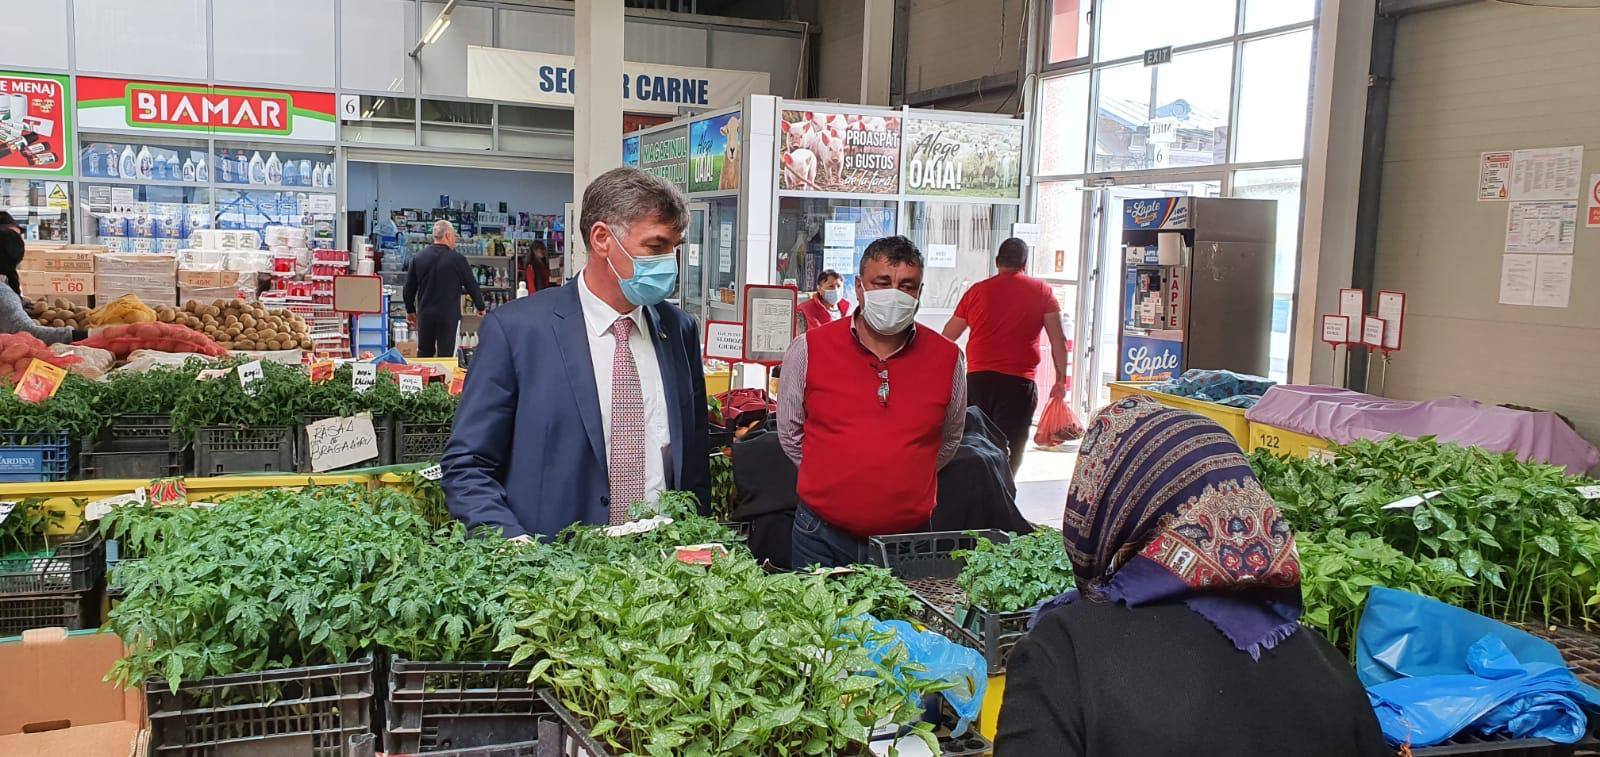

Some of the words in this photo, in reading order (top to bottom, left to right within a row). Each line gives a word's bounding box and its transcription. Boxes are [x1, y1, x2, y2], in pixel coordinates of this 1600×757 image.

[1147, 49, 1168, 63] EXIT
[11, 81, 55, 98] MENAJ
[636, 74, 709, 105] CARNE
[138, 92, 281, 128] BIAMAR
[345, 99, 356, 115] 6
[643, 136, 687, 163] MAGAZINUL
[913, 130, 961, 171] Alege
[855, 153, 894, 170] GUSTOS
[909, 159, 963, 191] OAIA!
[1131, 200, 1160, 218] Lapte
[68, 281, 84, 293] 60
[1171, 267, 1179, 327] LAPTE
[1124, 345, 1179, 379] Lapte
[1260, 433, 1280, 449] 122
